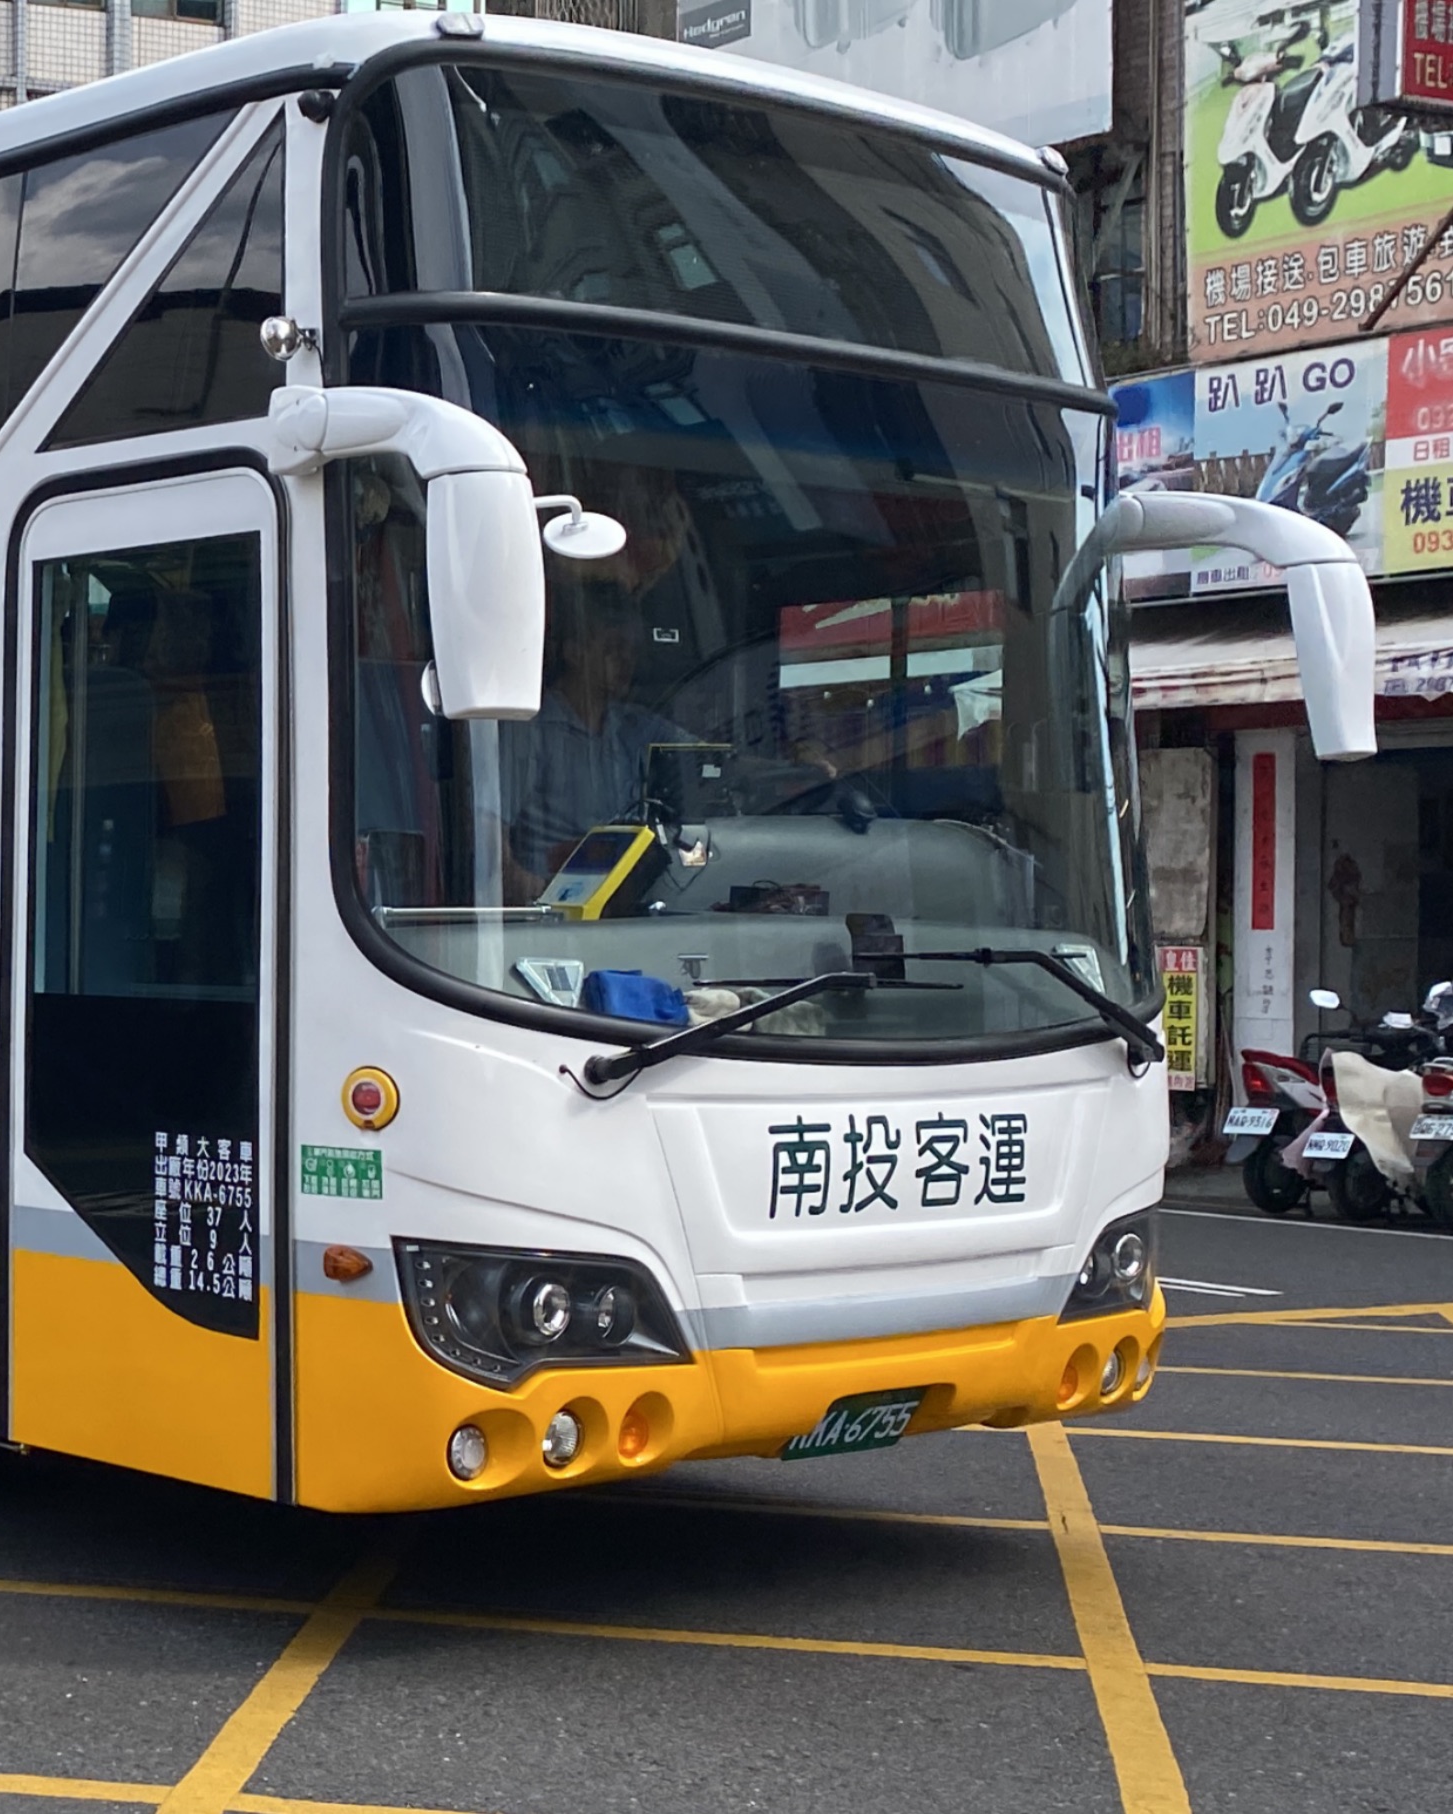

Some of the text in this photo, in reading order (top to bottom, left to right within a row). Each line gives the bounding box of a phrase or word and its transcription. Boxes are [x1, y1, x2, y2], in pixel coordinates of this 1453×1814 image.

[1302, 358, 1355, 392] GO
[1401, 476, 1453, 526] 機
[1167, 975, 1193, 1072] 機車託運
[768, 1112, 1027, 1218] 南投客運
